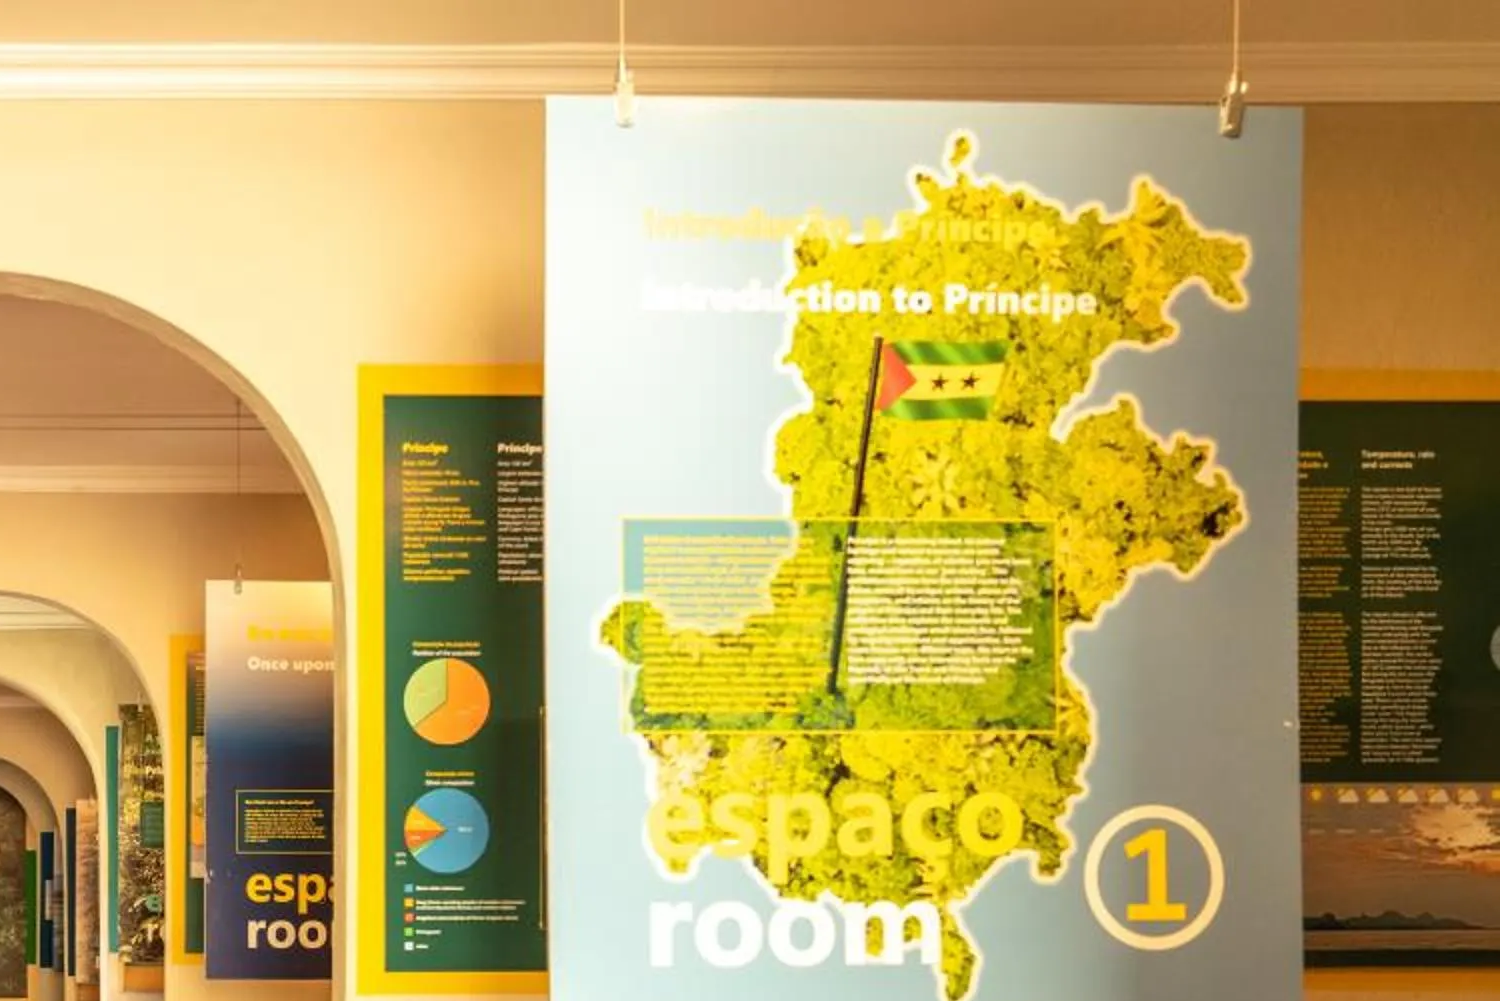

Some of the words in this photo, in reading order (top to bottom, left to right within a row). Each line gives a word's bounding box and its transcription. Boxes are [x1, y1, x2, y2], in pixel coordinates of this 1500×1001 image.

[893, 286, 933, 314] to
[945, 282, 1097, 324] Príncipe
[247, 656, 288, 671] Once
[293, 659, 336, 675] upon
[649, 791, 1023, 885] espaço
[246, 872, 333, 915] esp
[1124, 828, 1187, 921] 1
[247, 920, 332, 949] roo
[650, 900, 942, 968] room
